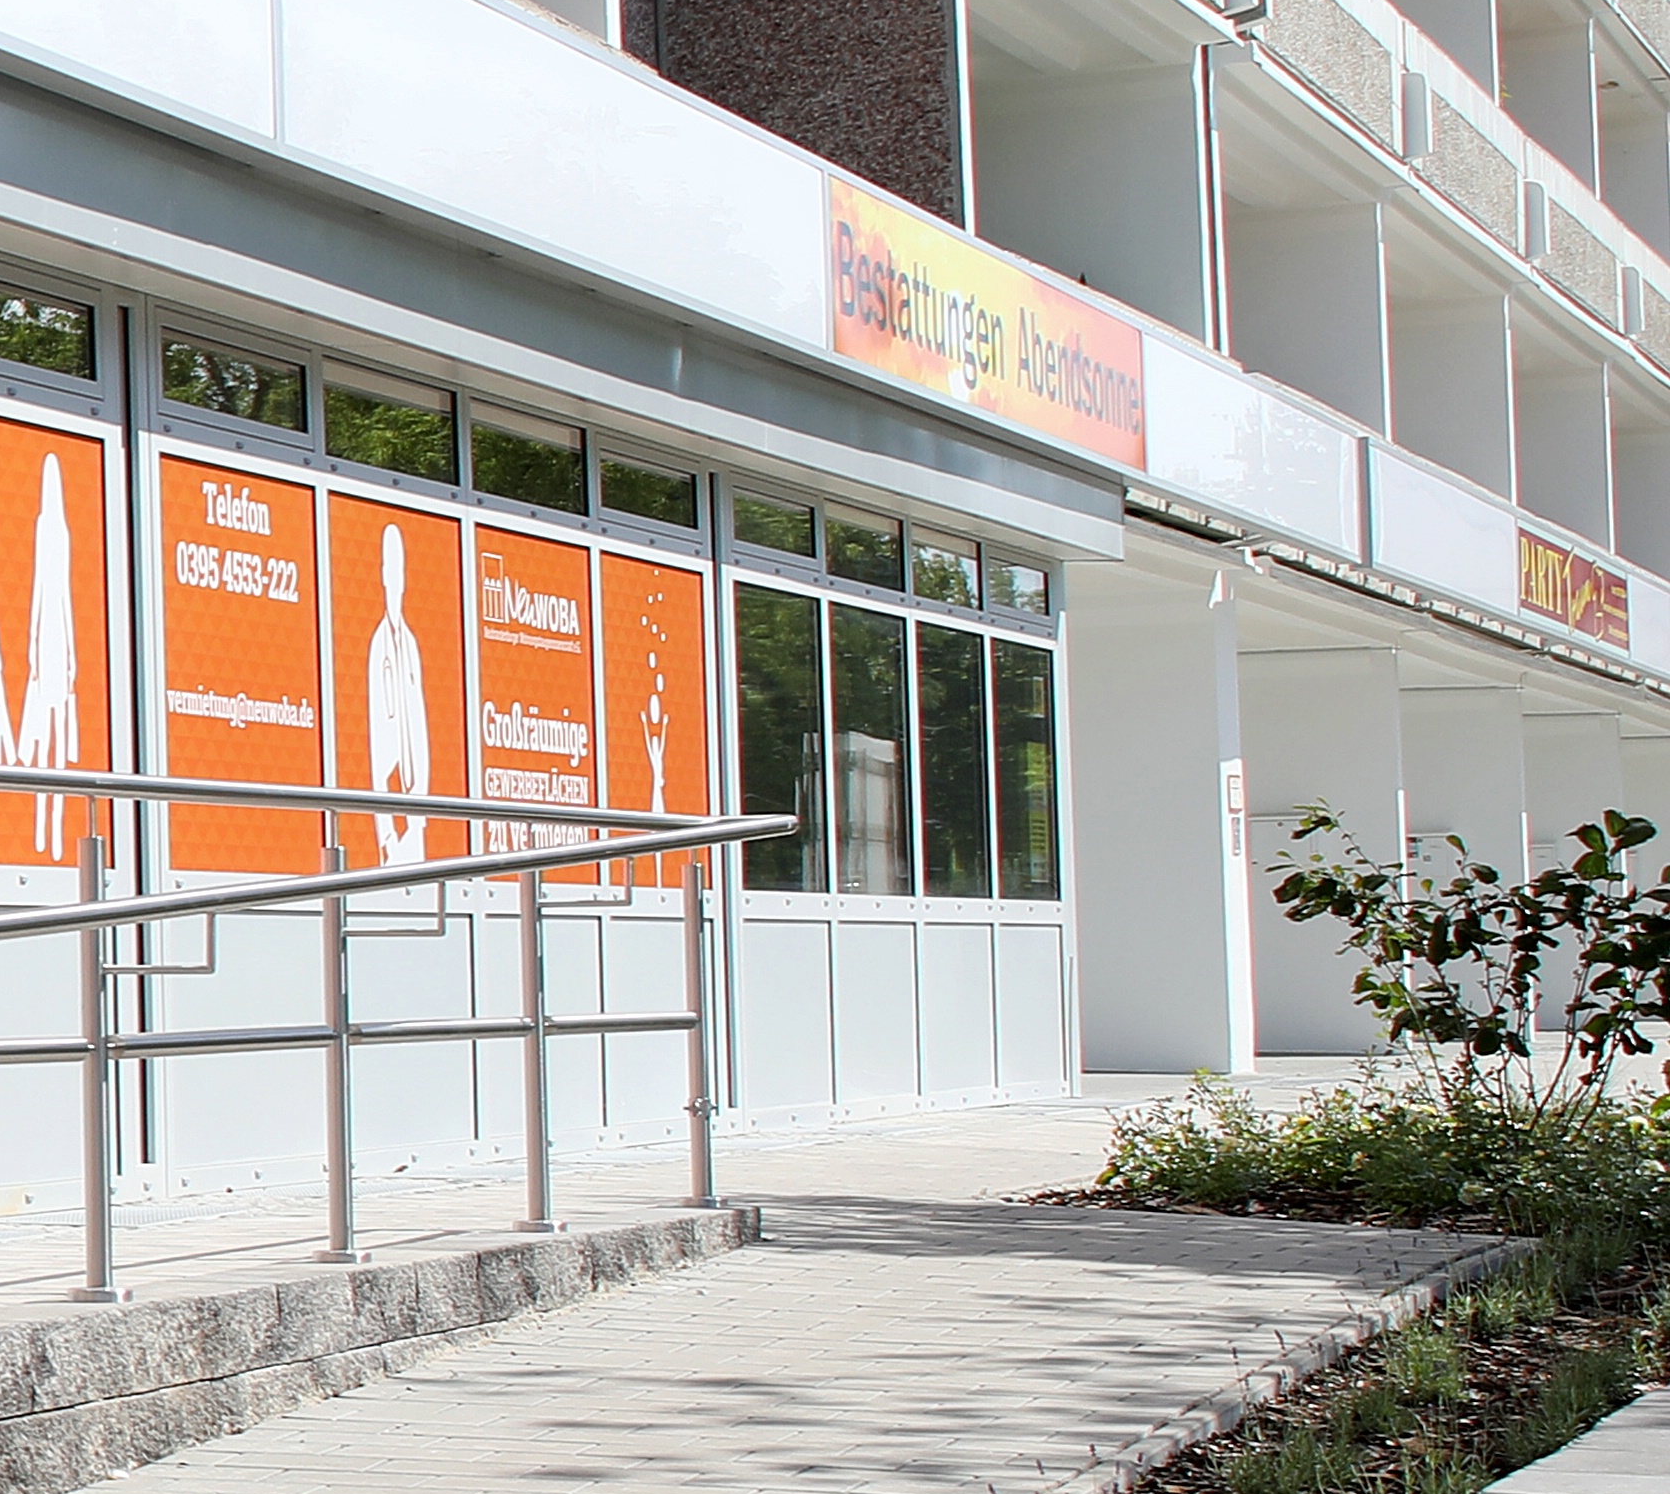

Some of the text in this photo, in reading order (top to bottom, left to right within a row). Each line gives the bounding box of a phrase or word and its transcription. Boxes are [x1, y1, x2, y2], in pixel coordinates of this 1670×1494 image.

[837, 220, 1140, 436] Bestattungen Abendsonne
[202, 481, 271, 535] Telefon
[176, 541, 299, 603] 0395 4553-222
[1520, 536, 1563, 615] PARTY
[504, 576, 580, 636] NeuWOBA
[167, 685, 314, 728] vermietung@neuwoba.de
[483, 701, 588, 767] Großräumige
[485, 767, 588, 805] GEWERBEFLÄCHEN
[489, 820, 508, 853] zu
